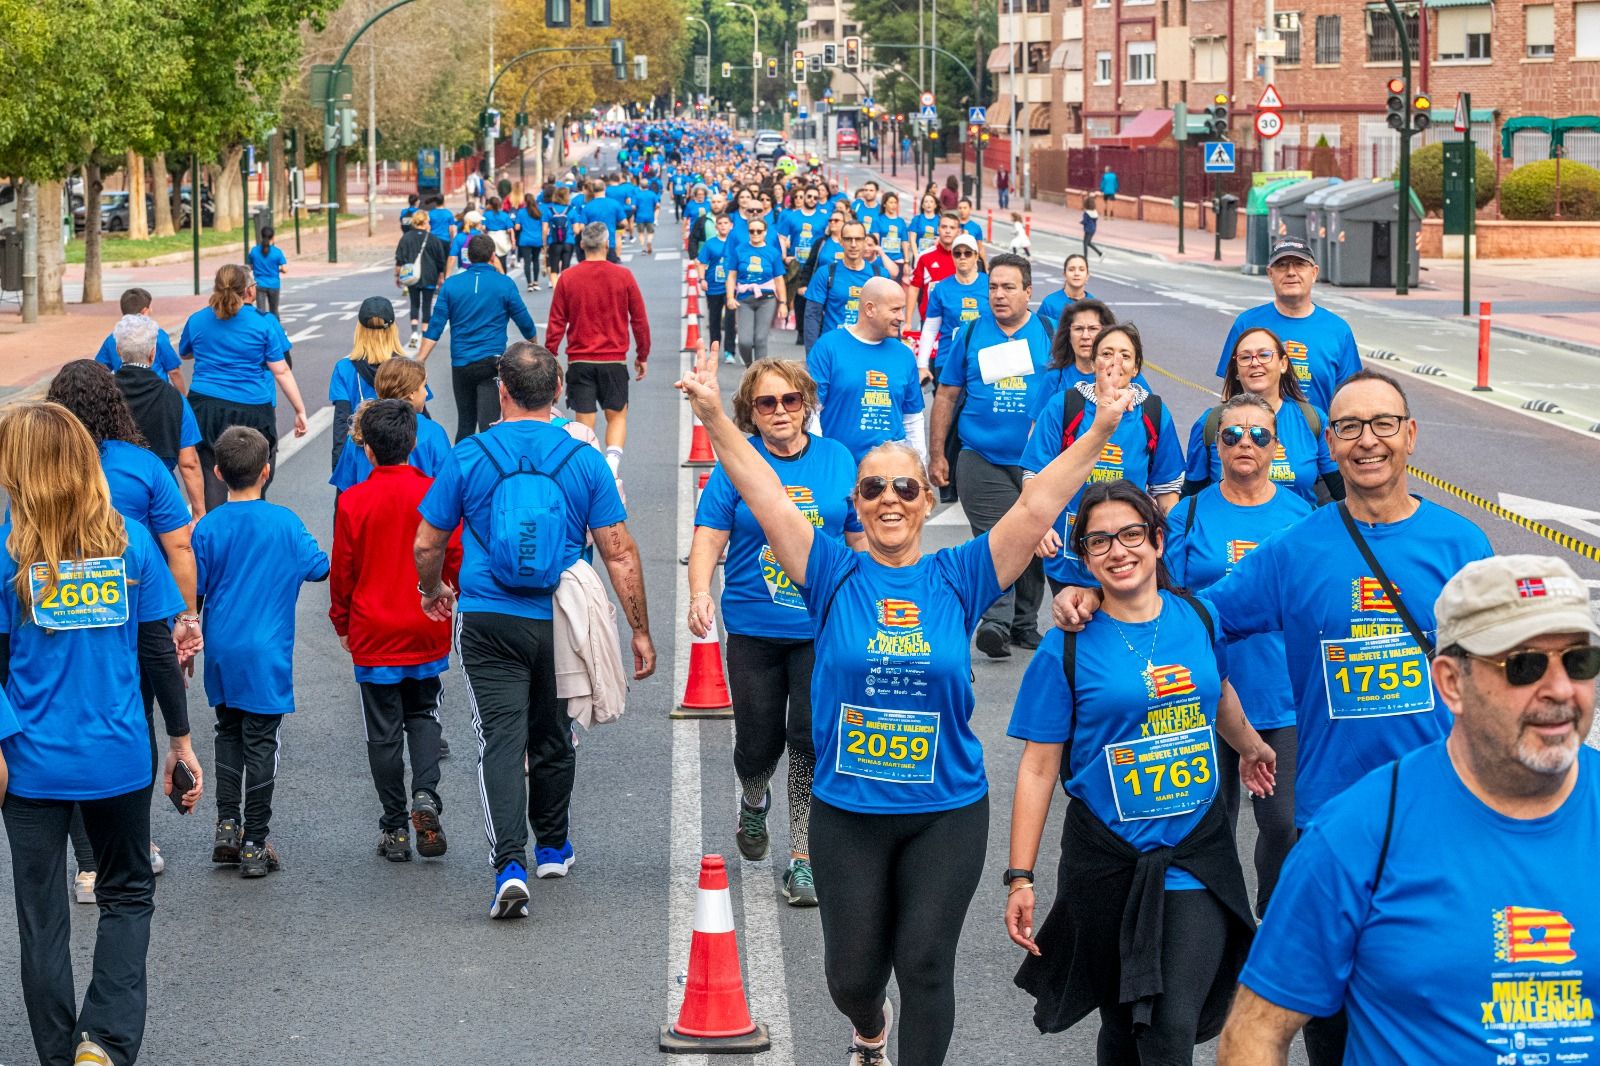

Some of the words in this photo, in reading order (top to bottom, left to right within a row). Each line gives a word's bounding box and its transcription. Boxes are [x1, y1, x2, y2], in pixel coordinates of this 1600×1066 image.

[1261, 119, 1277, 129] 30
[518, 521, 537, 577] PABLO
[41, 581, 120, 609] 2606
[1350, 622, 1403, 638] MUÉVETE
[867, 638, 876, 650] X
[879, 640, 931, 654] VALENCIA
[1349, 651, 1381, 662] MUÉVETE
[1382, 651, 1389, 659] X
[1389, 646, 1423, 658] VALENCIA
[1335, 660, 1422, 693] 1755
[1382, 692, 1401, 700] JOSÉ
[1148, 702, 1200, 723] MUÉVETE
[866, 720, 896, 731] MUÉVETE
[897, 723, 902, 732] X
[904, 725, 934, 733] VALENCIA
[1141, 723, 1150, 736] X
[1152, 713, 1206, 736] VALENCIA
[847, 730, 929, 761] 2059
[1138, 750, 1172, 762] MUÉVETE
[1173, 748, 1179, 757] X
[1179, 742, 1210, 755] VALENCIA
[857, 757, 881, 766] PRIMAS
[1123, 756, 1211, 796] 1763
[1492, 977, 1582, 1002] MUÉVETE
[1481, 1002, 1495, 1023] X
[1499, 998, 1594, 1023] VALENCIA
